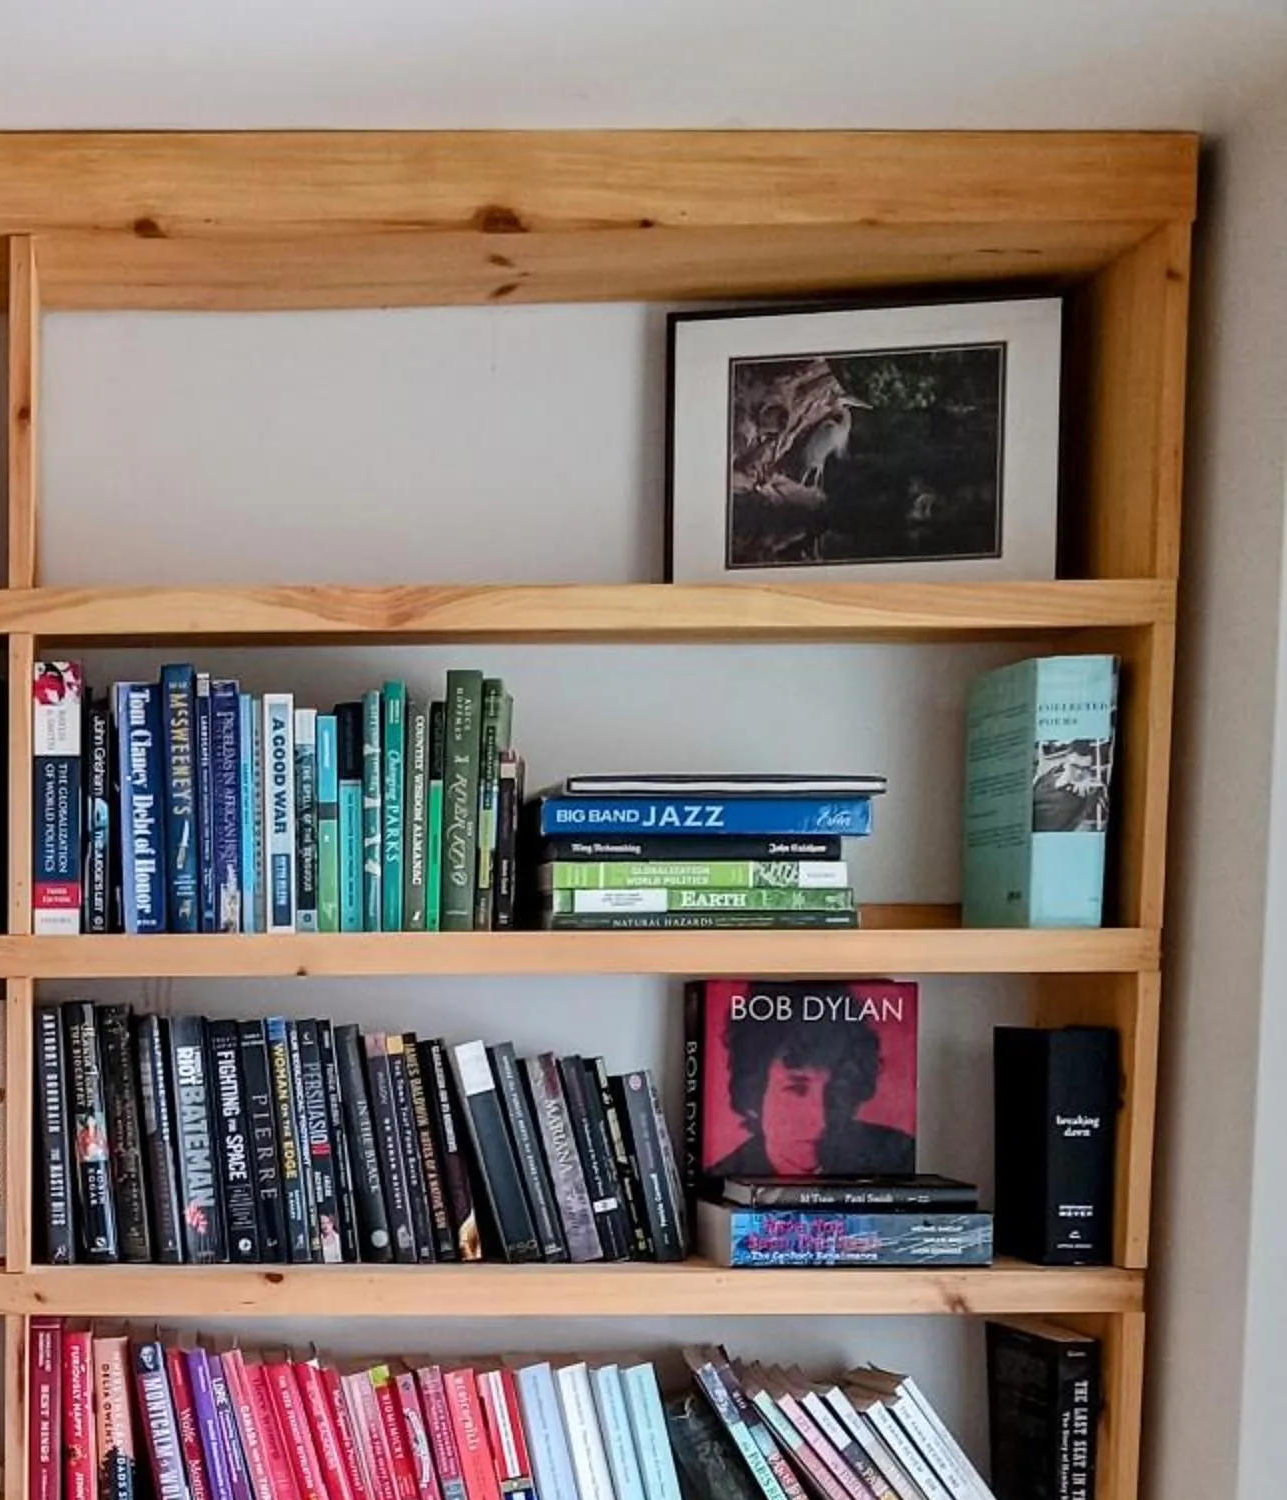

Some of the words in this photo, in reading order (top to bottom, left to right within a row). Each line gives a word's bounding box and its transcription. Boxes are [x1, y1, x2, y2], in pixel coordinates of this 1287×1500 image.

[128, 689, 150, 725] Tom
[273, 718, 286, 731] A
[92, 716, 105, 745] John
[414, 715, 425, 771] COUNTRY
[58, 763, 68, 785] THE
[93, 748, 105, 796] Grisham
[126, 729, 153, 787] Clancy
[274, 734, 286, 785] GOOD
[45, 784, 55, 821] WORLD
[132, 794, 153, 835] Debt
[274, 791, 287, 834] WAR
[413, 774, 424, 821] WISDOM
[556, 809, 586, 823] BIG
[588, 809, 639, 823] BAND
[642, 806, 724, 827] JAZZ
[58, 789, 68, 873] GLOBALIZATION
[135, 838, 155, 855] of
[385, 805, 400, 863] PARKS
[413, 824, 423, 885] ALMANAC
[135, 859, 156, 913] Honor
[681, 893, 746, 908] EARTH
[613, 919, 661, 928] NATURAL
[664, 917, 713, 927] HAZARDS
[730, 996, 792, 1021] BOB
[803, 997, 903, 1022] DYLAN
[43, 1014, 56, 1067] ANTHONY
[404, 1043, 419, 1077] JAMES
[176, 1046, 196, 1086] RIOT
[217, 1051, 240, 1117] FIGHTING
[273, 1043, 286, 1100] WOMAN
[281, 1103, 288, 1117] ON
[303, 1062, 331, 1155] PERSUASION
[356, 1100, 367, 1114] IN
[410, 1080, 429, 1127] BALDWIN
[181, 1086, 215, 1207] BATEMAN
[251, 1094, 278, 1202] PIERRE
[360, 1122, 372, 1143] THE
[543, 1099, 573, 1174] MARIANA
[226, 1135, 246, 1181] SPACE
[284, 1142, 297, 1179] EDGE
[362, 1149, 378, 1193] BLACK
[70, 1345, 82, 1400] FURIOUSLY
[102, 1363, 110, 1397] DELIA
[212, 1378, 227, 1406] LORE
[1074, 1381, 1088, 1403] THE
[40, 1384, 50, 1416] BEST
[142, 1378, 169, 1458] MONTCALM
[72, 1404, 82, 1437] HAPPY
[103, 1403, 113, 1444] OWENS
[180, 1407, 194, 1444] Wolfe
[240, 1405, 257, 1445] CANADA
[1073, 1407, 1087, 1435] LAST
[40, 1422, 50, 1463] MINDS
[1073, 1440, 1087, 1467] SEAT
[746, 1451, 773, 1486] PARIS
[1072, 1473, 1085, 1485] IN
